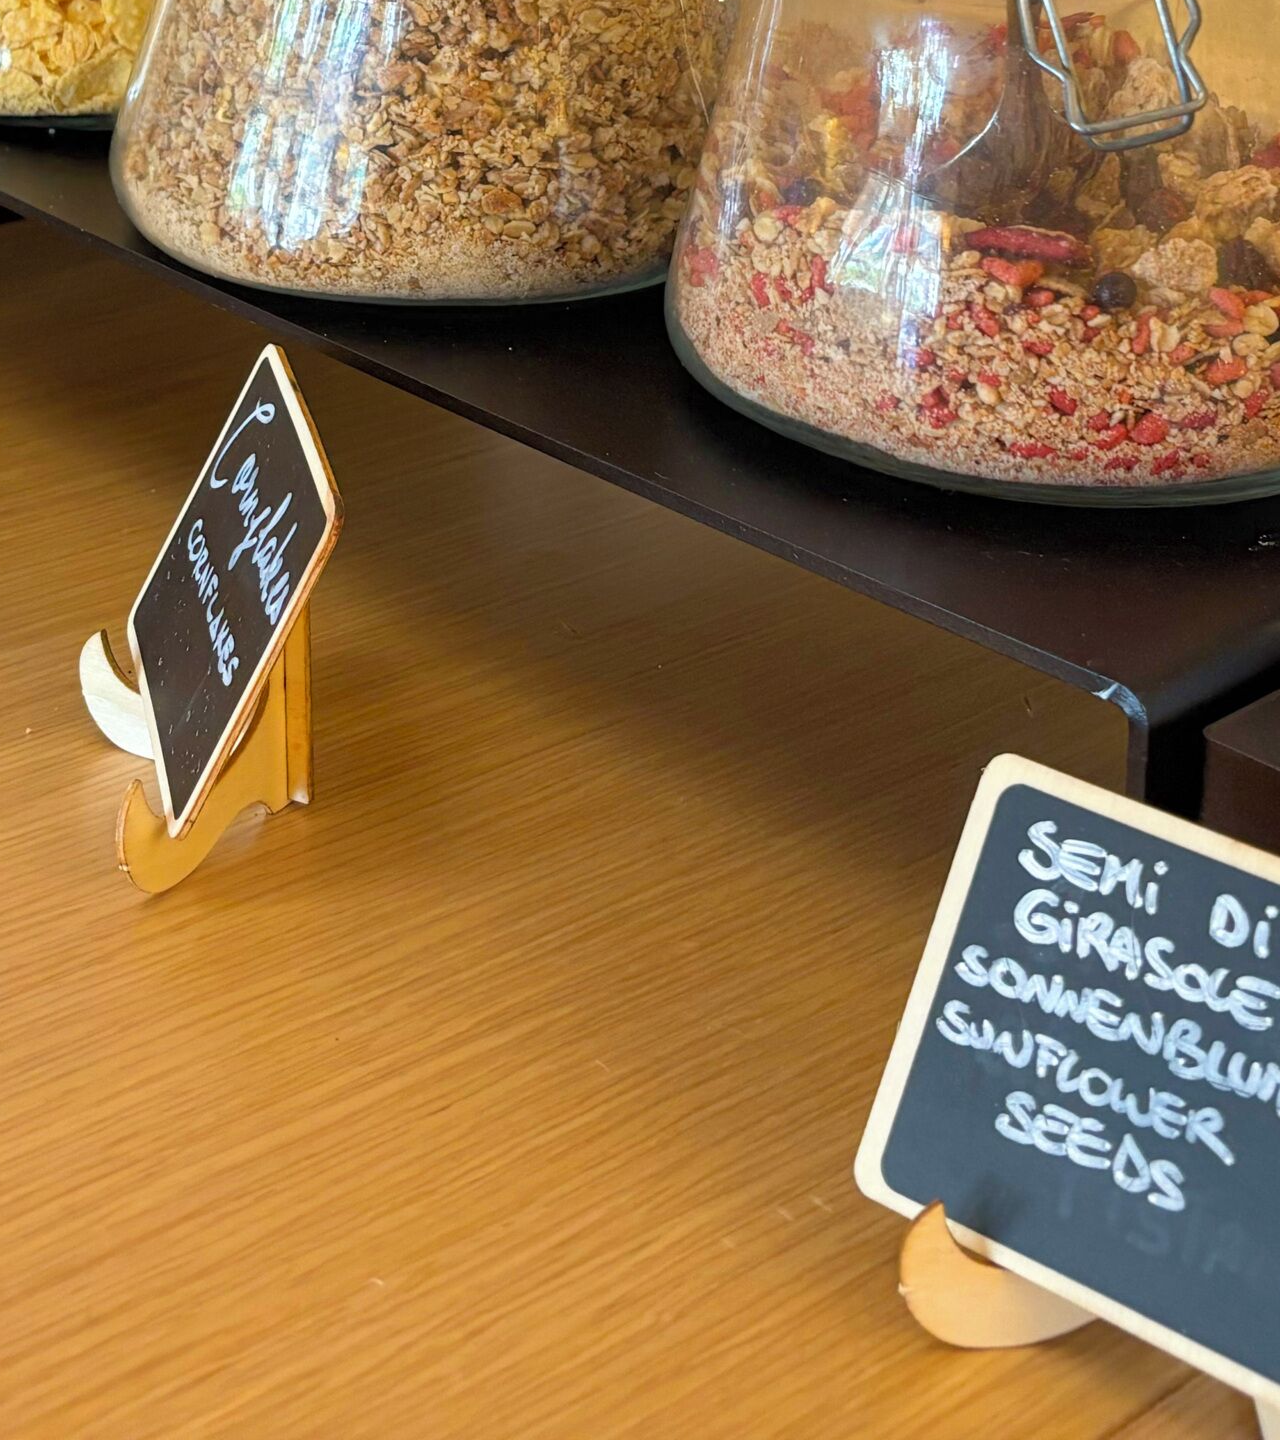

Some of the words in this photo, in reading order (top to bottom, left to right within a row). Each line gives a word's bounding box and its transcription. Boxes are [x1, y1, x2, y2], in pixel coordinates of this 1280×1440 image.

[210, 401, 297, 625] Cornflakes
[188, 519, 239, 686] CORNFLAKES
[936, 1000, 1234, 1166] SUNFLOWER
[995, 1091, 1185, 1211] SEEDS
